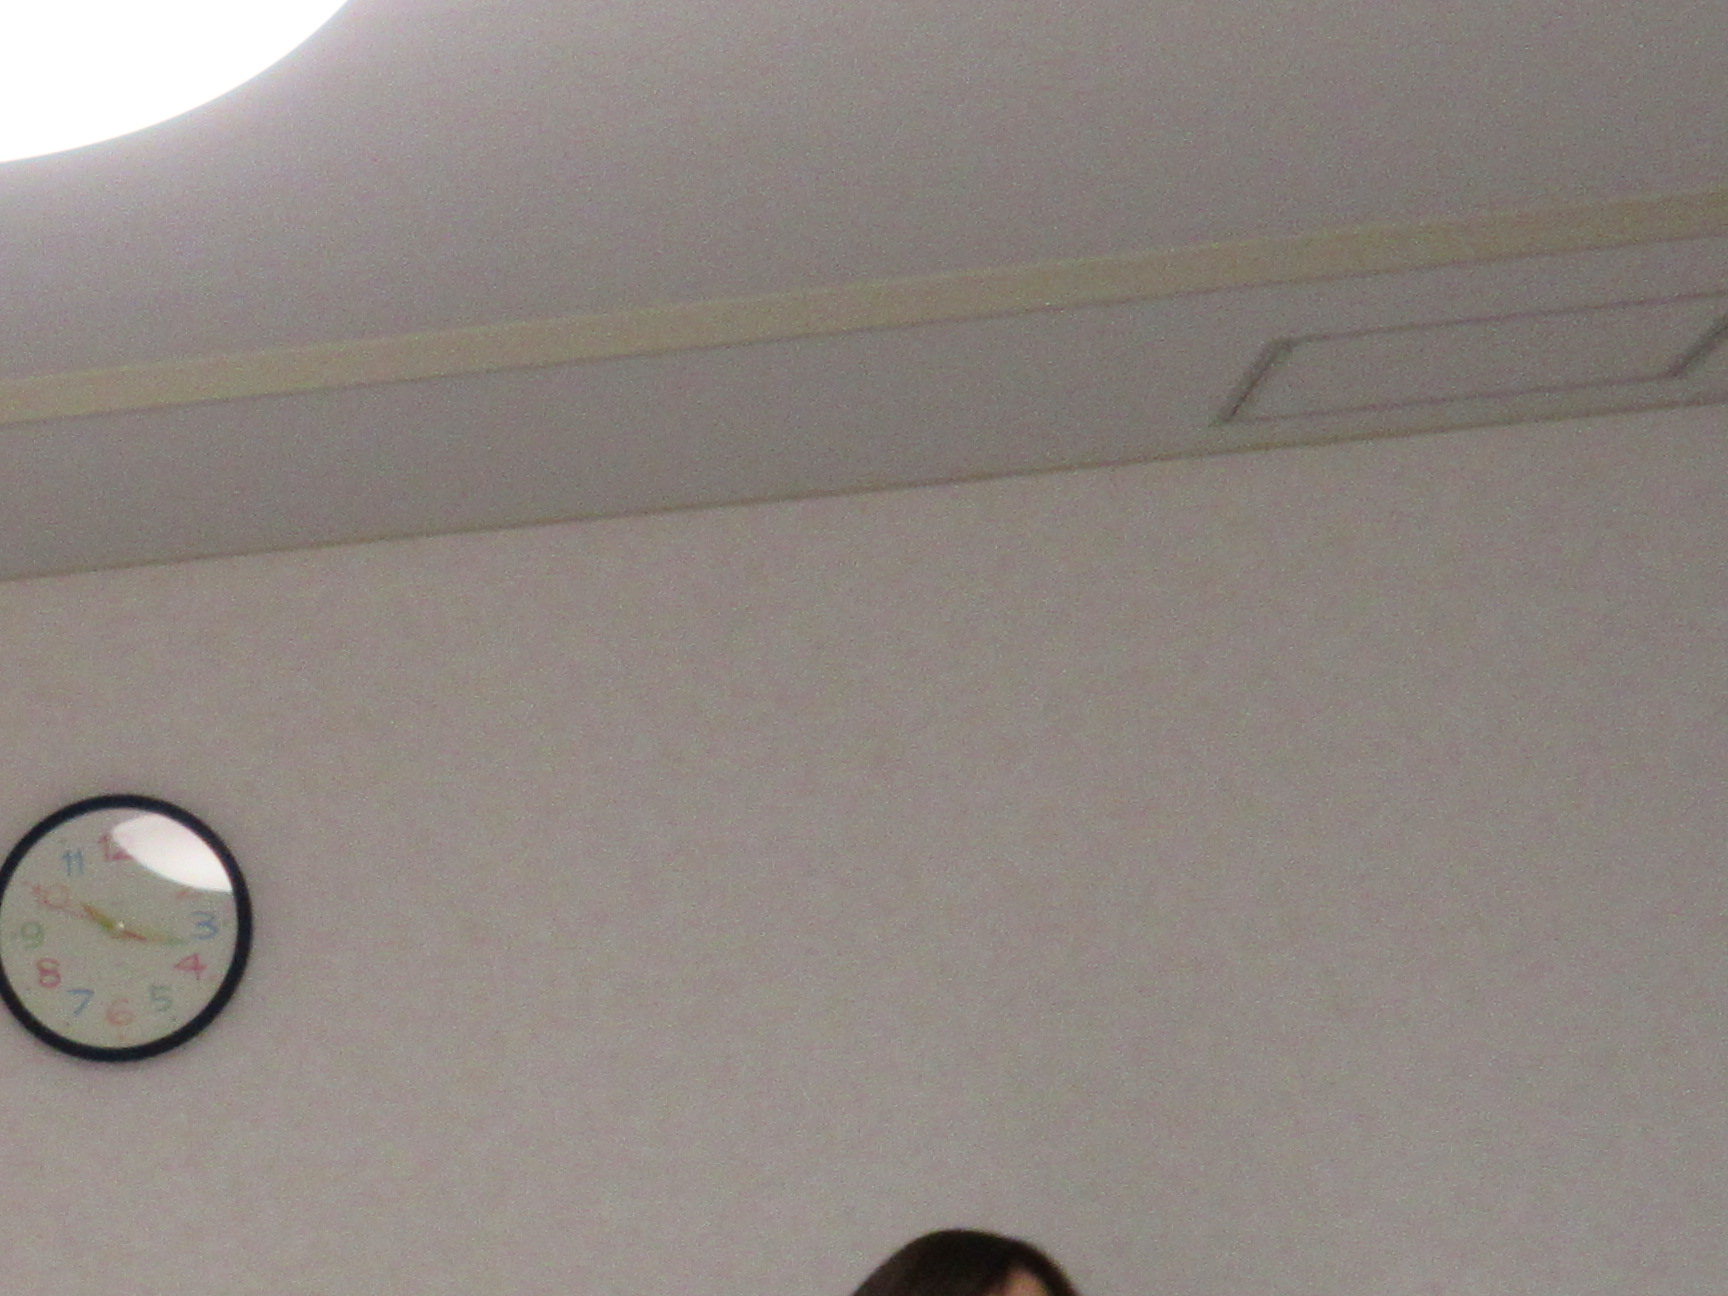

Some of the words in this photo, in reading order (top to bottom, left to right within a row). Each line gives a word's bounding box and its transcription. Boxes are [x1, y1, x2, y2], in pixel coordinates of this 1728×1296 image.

[61, 849, 85, 877] 11
[19, 920, 45, 949] 9
[190, 910, 220, 941] 3
[36, 957, 62, 989] 8
[174, 952, 208, 981] 4
[66, 988, 95, 1017] 7
[105, 997, 134, 1027] 6
[148, 984, 173, 1013] 5
